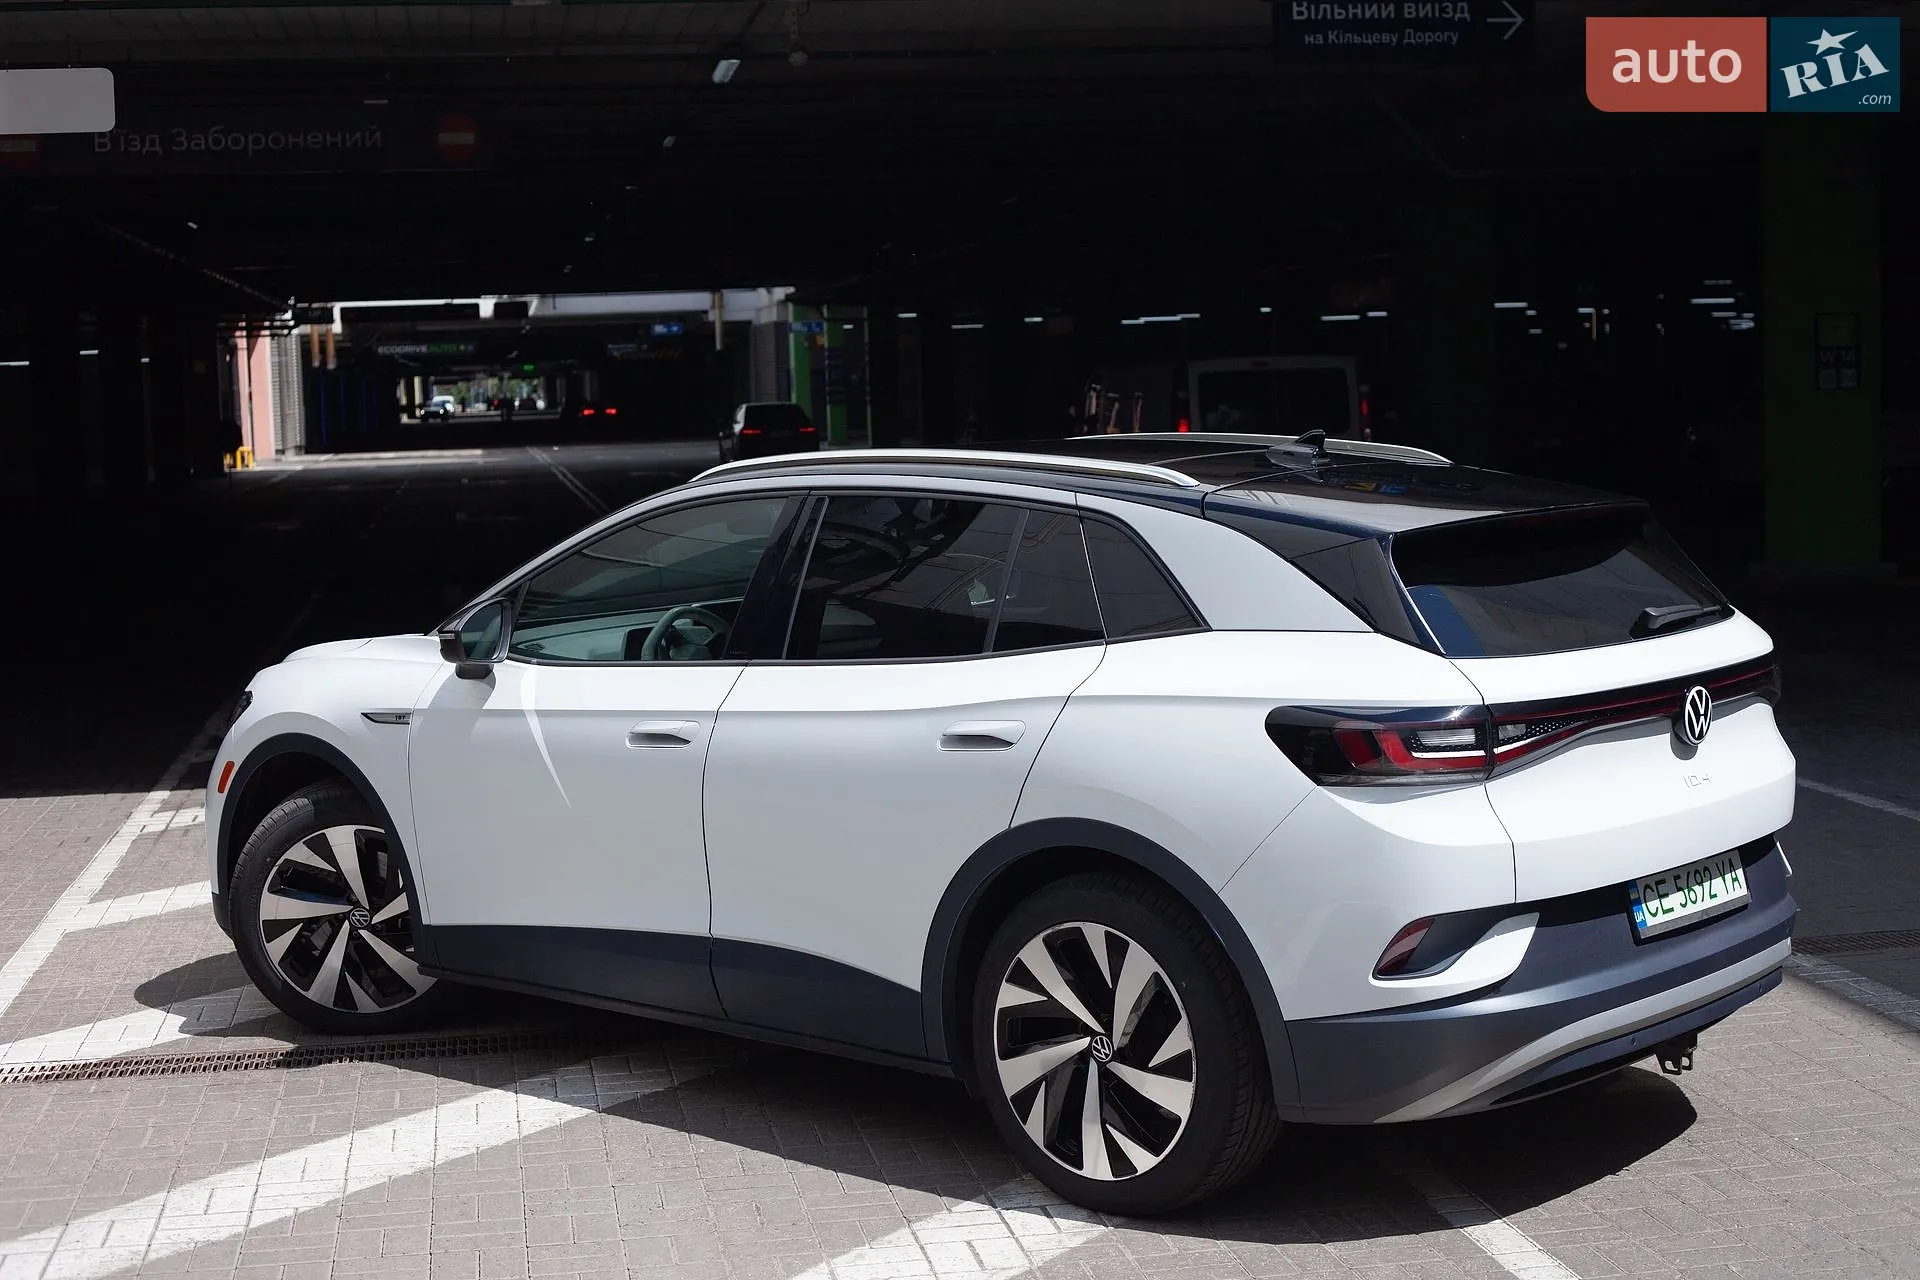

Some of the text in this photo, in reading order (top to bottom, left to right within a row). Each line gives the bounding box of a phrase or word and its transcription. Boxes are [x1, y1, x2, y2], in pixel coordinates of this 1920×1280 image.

[1304, 28, 1459, 46] на Кільцеву Дорогу
[171, 123, 383, 158] Заборонений
[1642, 857, 1743, 918] CE 5692 YA
[1634, 910, 1646, 923] UA
